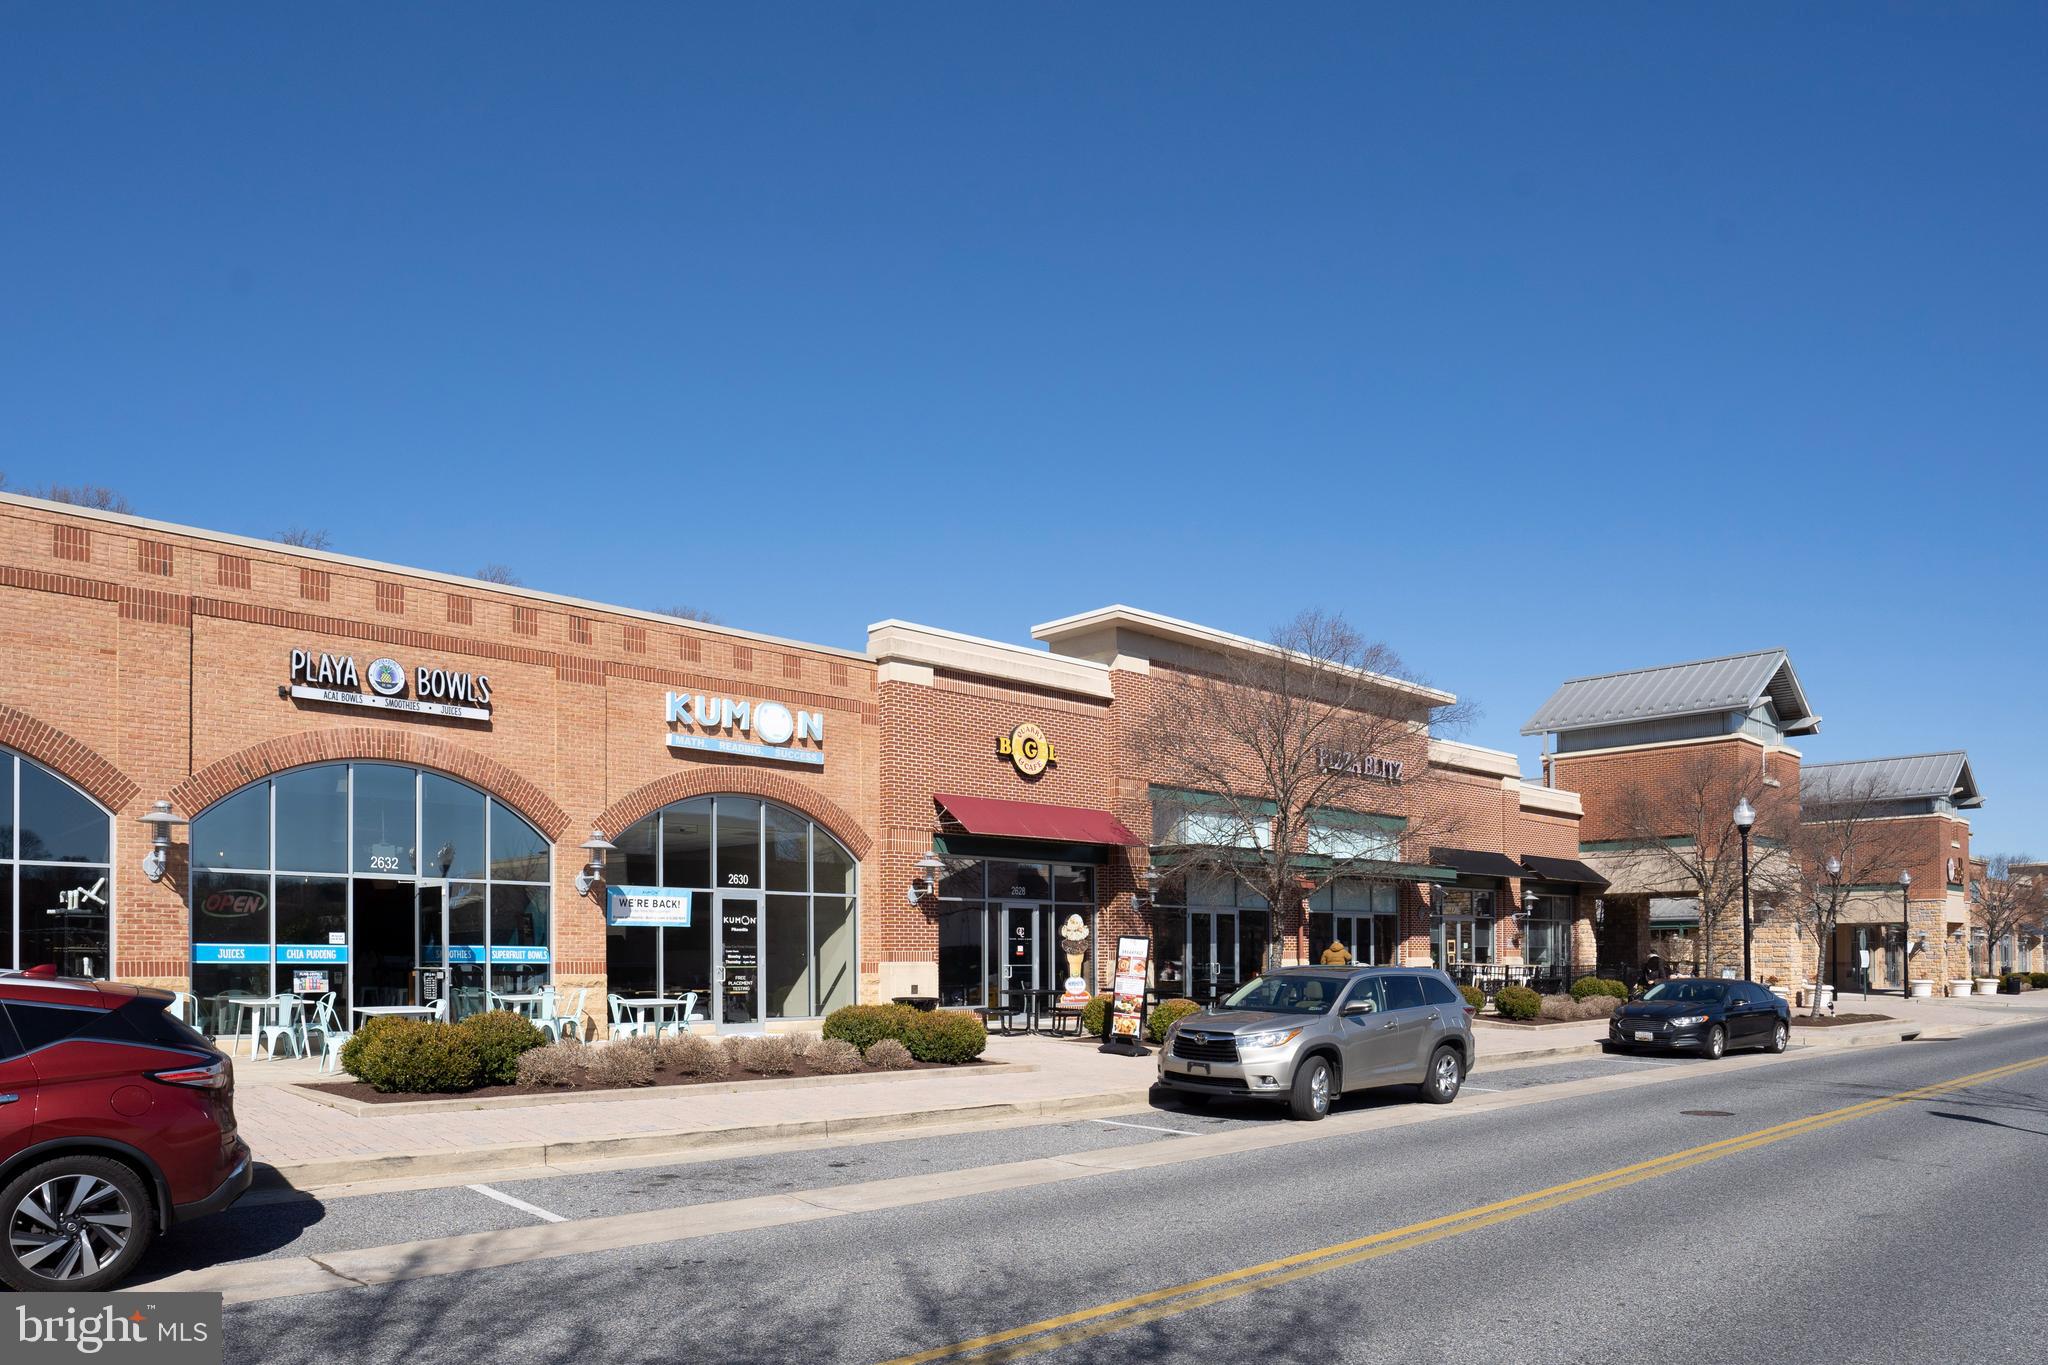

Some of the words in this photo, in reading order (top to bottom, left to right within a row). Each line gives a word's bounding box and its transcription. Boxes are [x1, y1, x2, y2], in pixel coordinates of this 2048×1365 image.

[291, 650, 359, 686] PLAYA
[417, 667, 490, 703] BOWLS
[323, 690, 339, 701] ACAI
[341, 693, 363, 704] BOWLS
[384, 698, 421, 711] SMOOTHIES
[440, 705, 462, 716] JUICES
[666, 691, 824, 744] KUMON
[1017, 726, 1043, 740] QUARRY
[370, 856, 399, 869] 2632
[728, 874, 749, 885] 2630
[1011, 886, 1026, 896] 2628
[206, 896, 261, 914] OPEN
[619, 899, 649, 908] WE'RE
[652, 900, 681, 909] BACK!
[723, 915, 757, 926] KUMON
[217, 949, 245, 959] JUICES
[286, 949, 305, 959] CHIA
[306, 949, 337, 960] PUDDING
[491, 950, 526, 960] SUPERFRUIT
[528, 950, 548, 960] BOWLS
